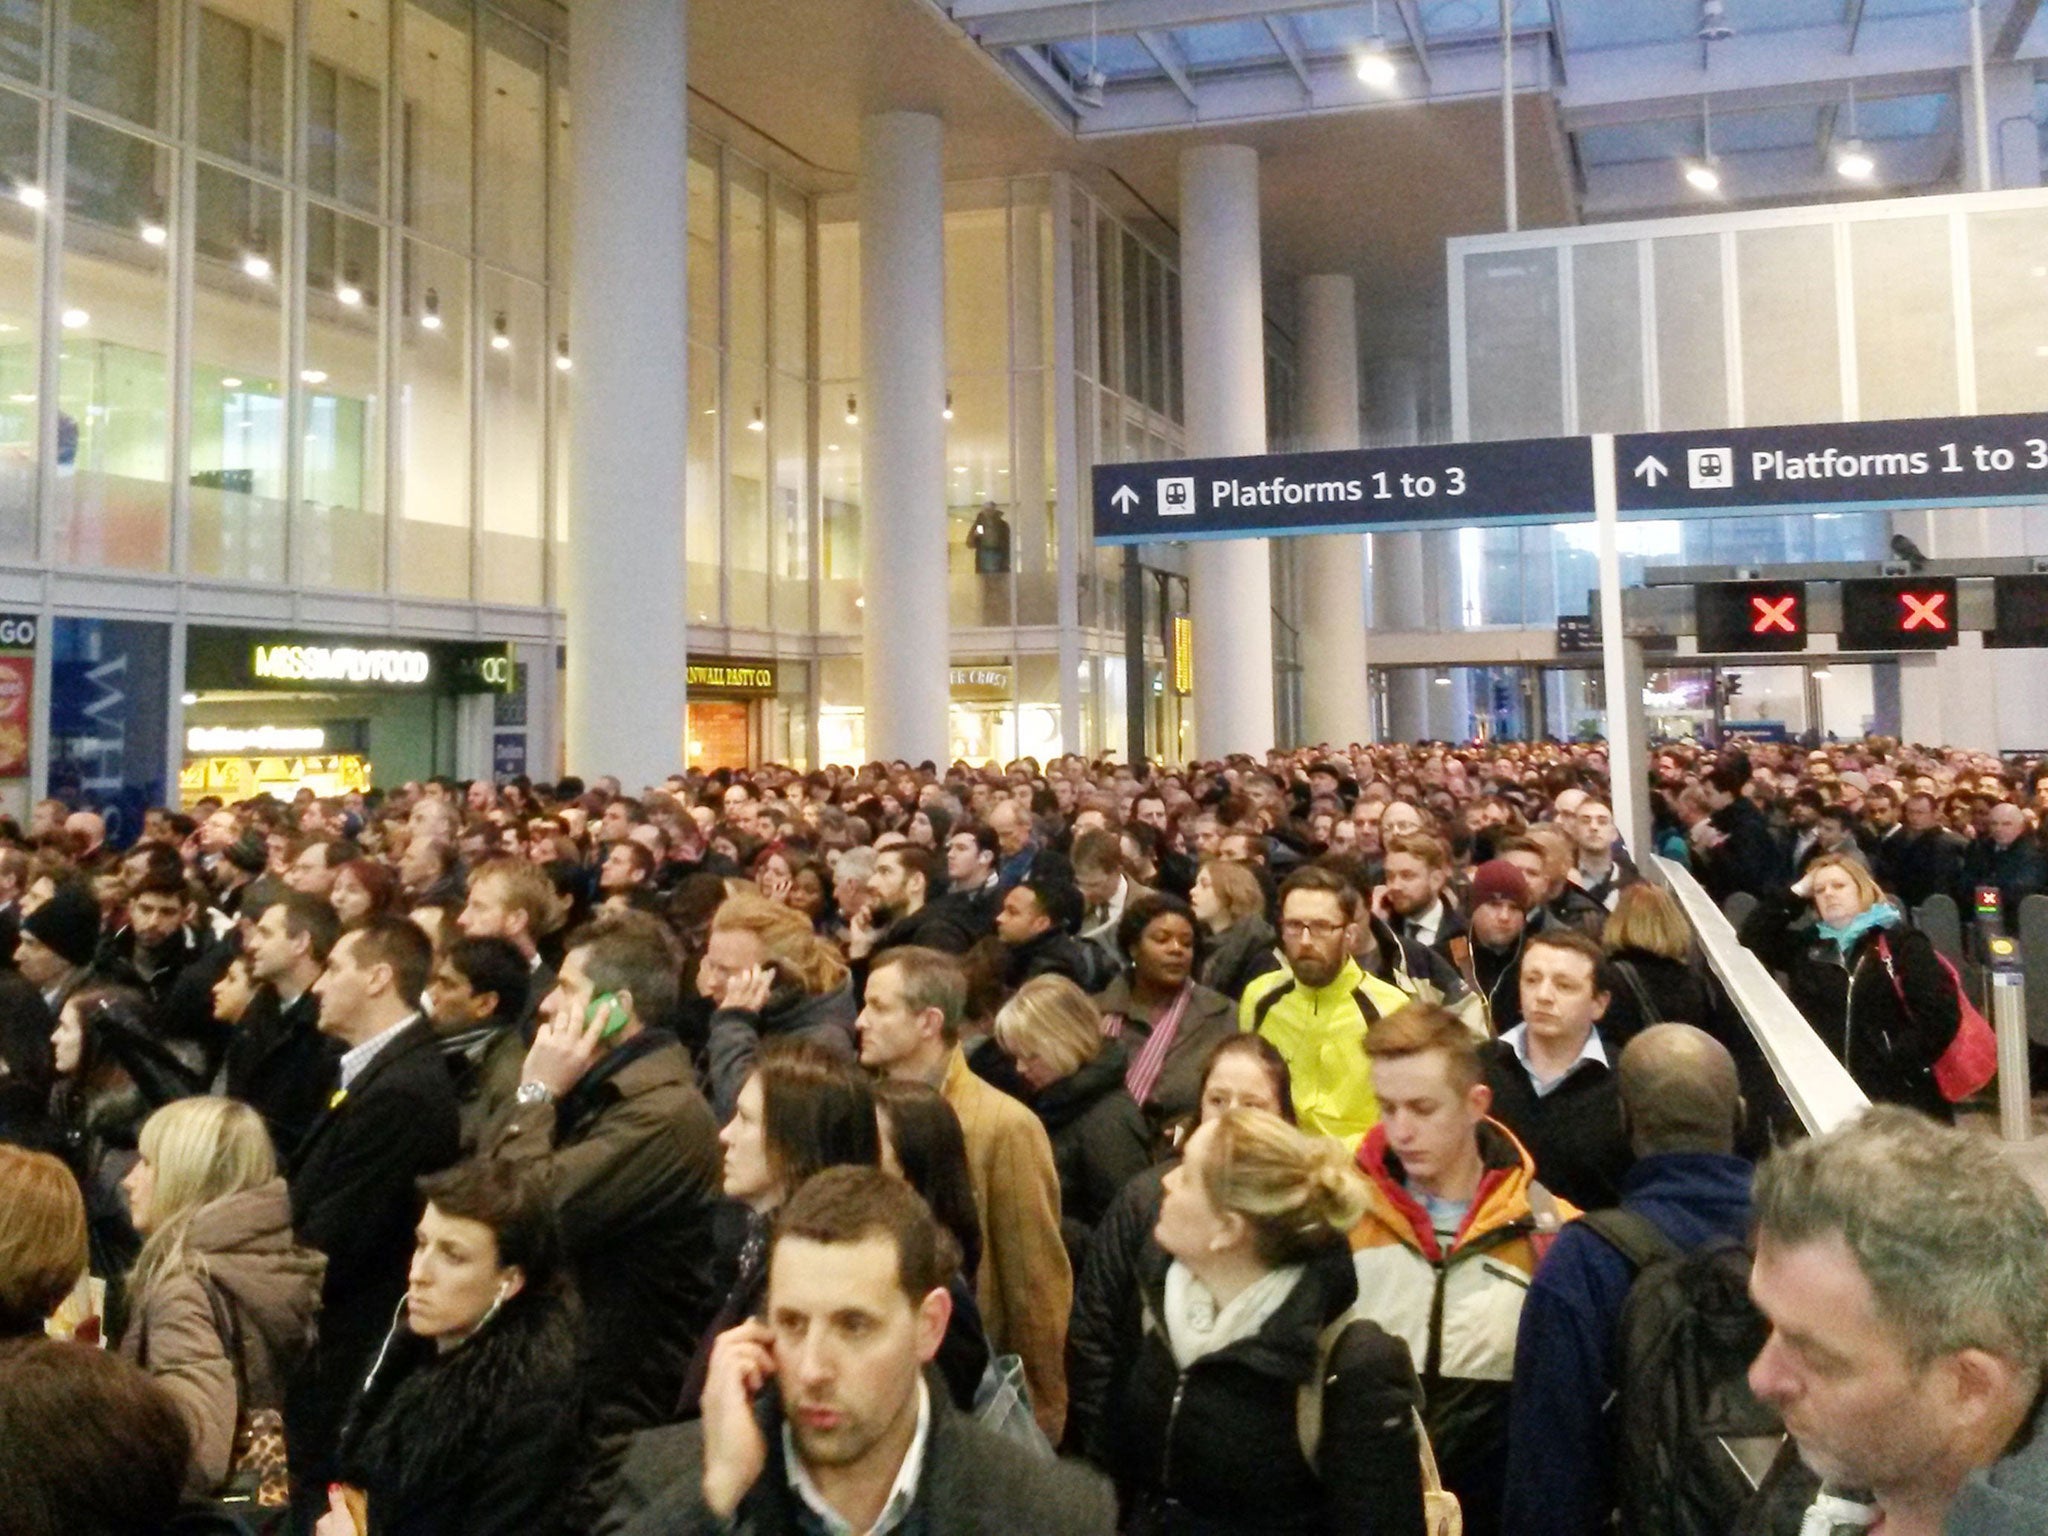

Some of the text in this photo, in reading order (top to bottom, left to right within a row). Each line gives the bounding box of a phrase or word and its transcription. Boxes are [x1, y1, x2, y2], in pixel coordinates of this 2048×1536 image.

[1752, 438, 2048, 481] Platforms 1 to 3
[1212, 467, 1466, 507] Platforms 1 to 3
